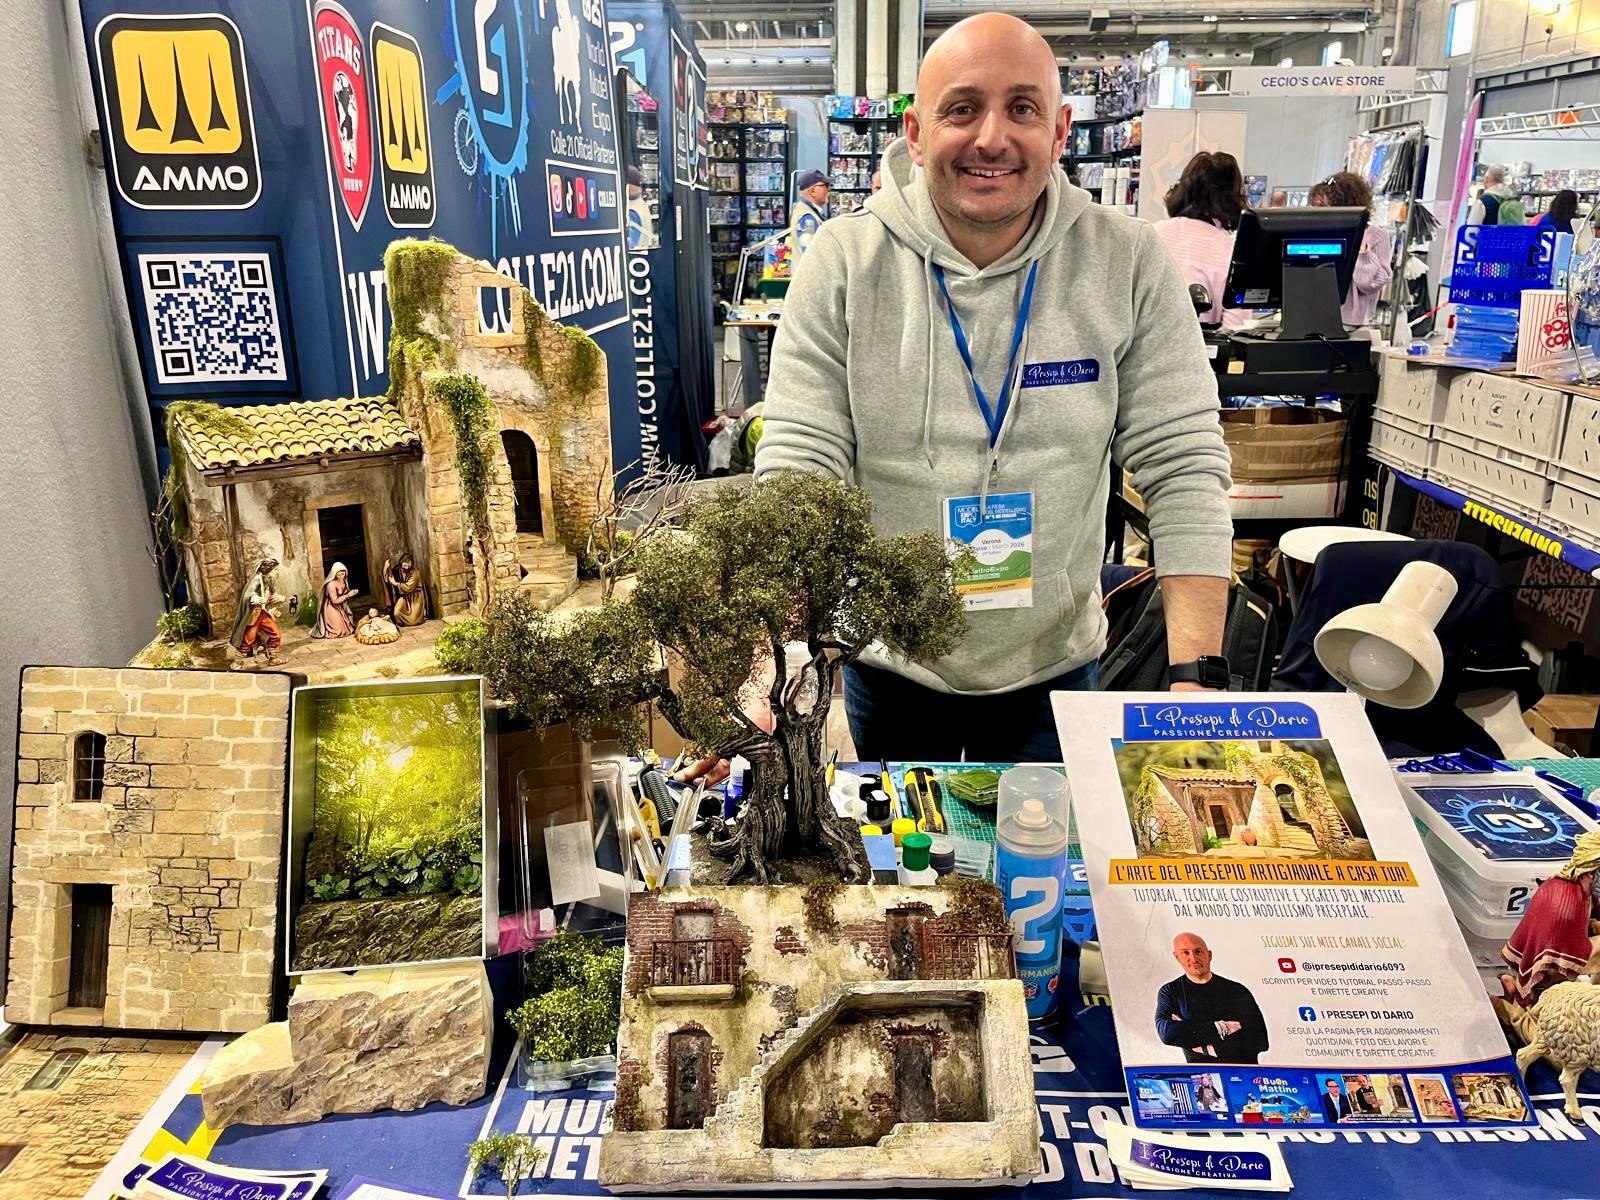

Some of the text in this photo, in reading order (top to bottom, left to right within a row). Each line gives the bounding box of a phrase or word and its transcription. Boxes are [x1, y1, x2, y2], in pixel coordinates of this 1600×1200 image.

[317, 26, 361, 76] TITANS
[1261, 75, 1385, 87] CECIO'S CAVE STORE
[591, 103, 612, 136] Expo
[550, 129, 567, 156] Colle
[132, 165, 249, 191] AMMO
[390, 182, 431, 210] AMMO
[1134, 705, 1309, 733] I Presepi di Dario
[1153, 729, 1275, 737] PASSIONE CREATIVA
[1115, 863, 1410, 882] L'ARTE DEL PRESEPIO ARTIGIANALE A CASA TUA!
[1132, 888, 1406, 904] TUTORIAL, TECNICHE COSTRUTTIVE E SEGRETI DEL MESTIERE
[1173, 903, 1193, 917] DAL
[1194, 904, 1231, 917] MONDO
[1232, 904, 1250, 918] DEL
[1251, 904, 1314, 918] MODELLISMO
[1260, 935, 1298, 948] SEGUIMI
[1300, 935, 1316, 949] SUI
[1317, 935, 1340, 949] MIEI
[1341, 936, 1371, 949] CANALI
[1302, 962, 1406, 973] @ipresepididario6093
[1261, 977, 1432, 987] ISCRIVITI PER VIDEO TUTORIAL PASSO-PASSO
[1311, 988, 1389, 996] E DIRETTE CREATIVE
[1320, 1010, 1415, 1020] I PRESEPI DI DARIO
[1286, 1027, 1440, 1036] SEGUI LA PAGINA PER AGGIORNAMENTI
[1305, 1038, 1429, 1047] QUOTIDIANI, FOTO DEI LAVORI E
[1305, 1048, 1437, 1058] COMMUNITY E DIRETTE CREATIVE
[1262, 1077, 1288, 1086] Buon
[1259, 1084, 1299, 1094] Mattino
[1152, 1148, 1201, 1174] Presepi
[1205, 1154, 1214, 1170] di
[1218, 1154, 1264, 1172] Dario
[1150, 1162, 1238, 1179] PASSIONE CREATIVA
[182, 1171, 224, 1198] Presepi
